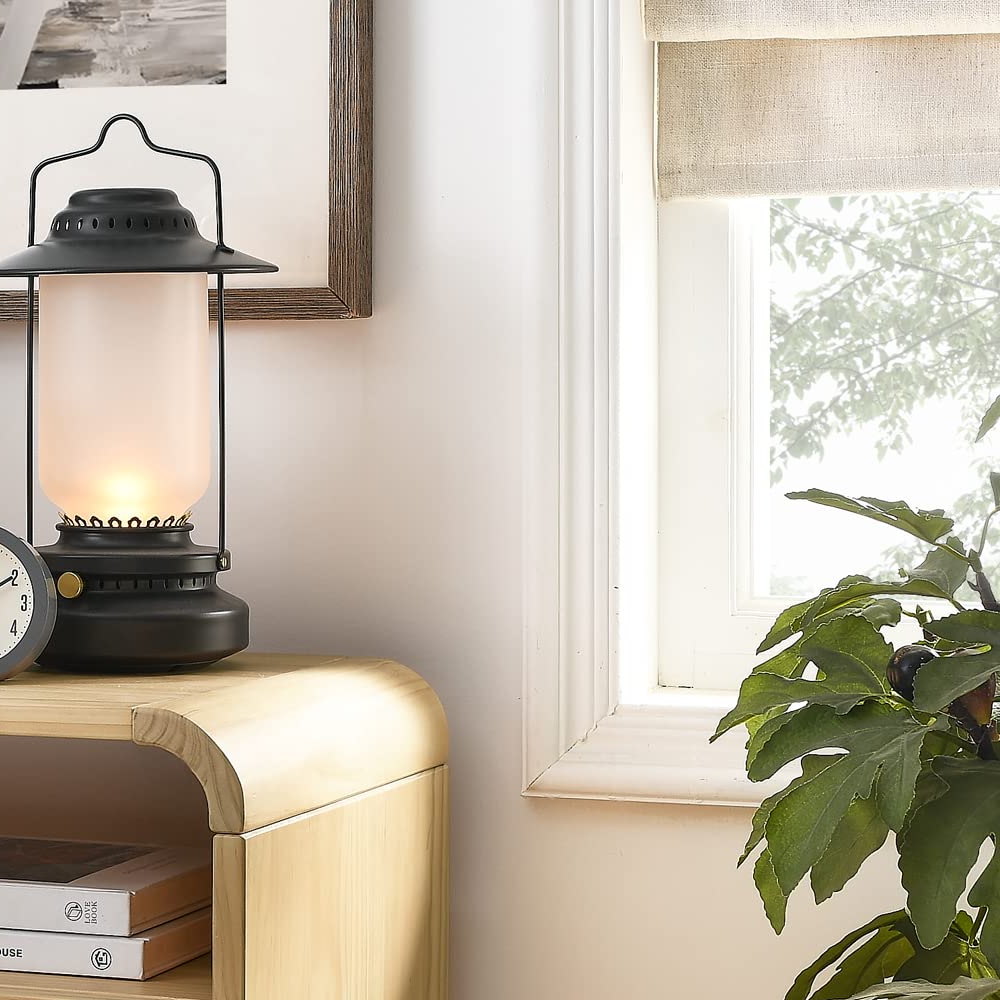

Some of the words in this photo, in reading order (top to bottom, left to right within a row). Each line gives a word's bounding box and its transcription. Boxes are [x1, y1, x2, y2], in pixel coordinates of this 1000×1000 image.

[11, 569, 19, 586] 2
[21, 595, 28, 611] 3
[10, 620, 17, 636] 4
